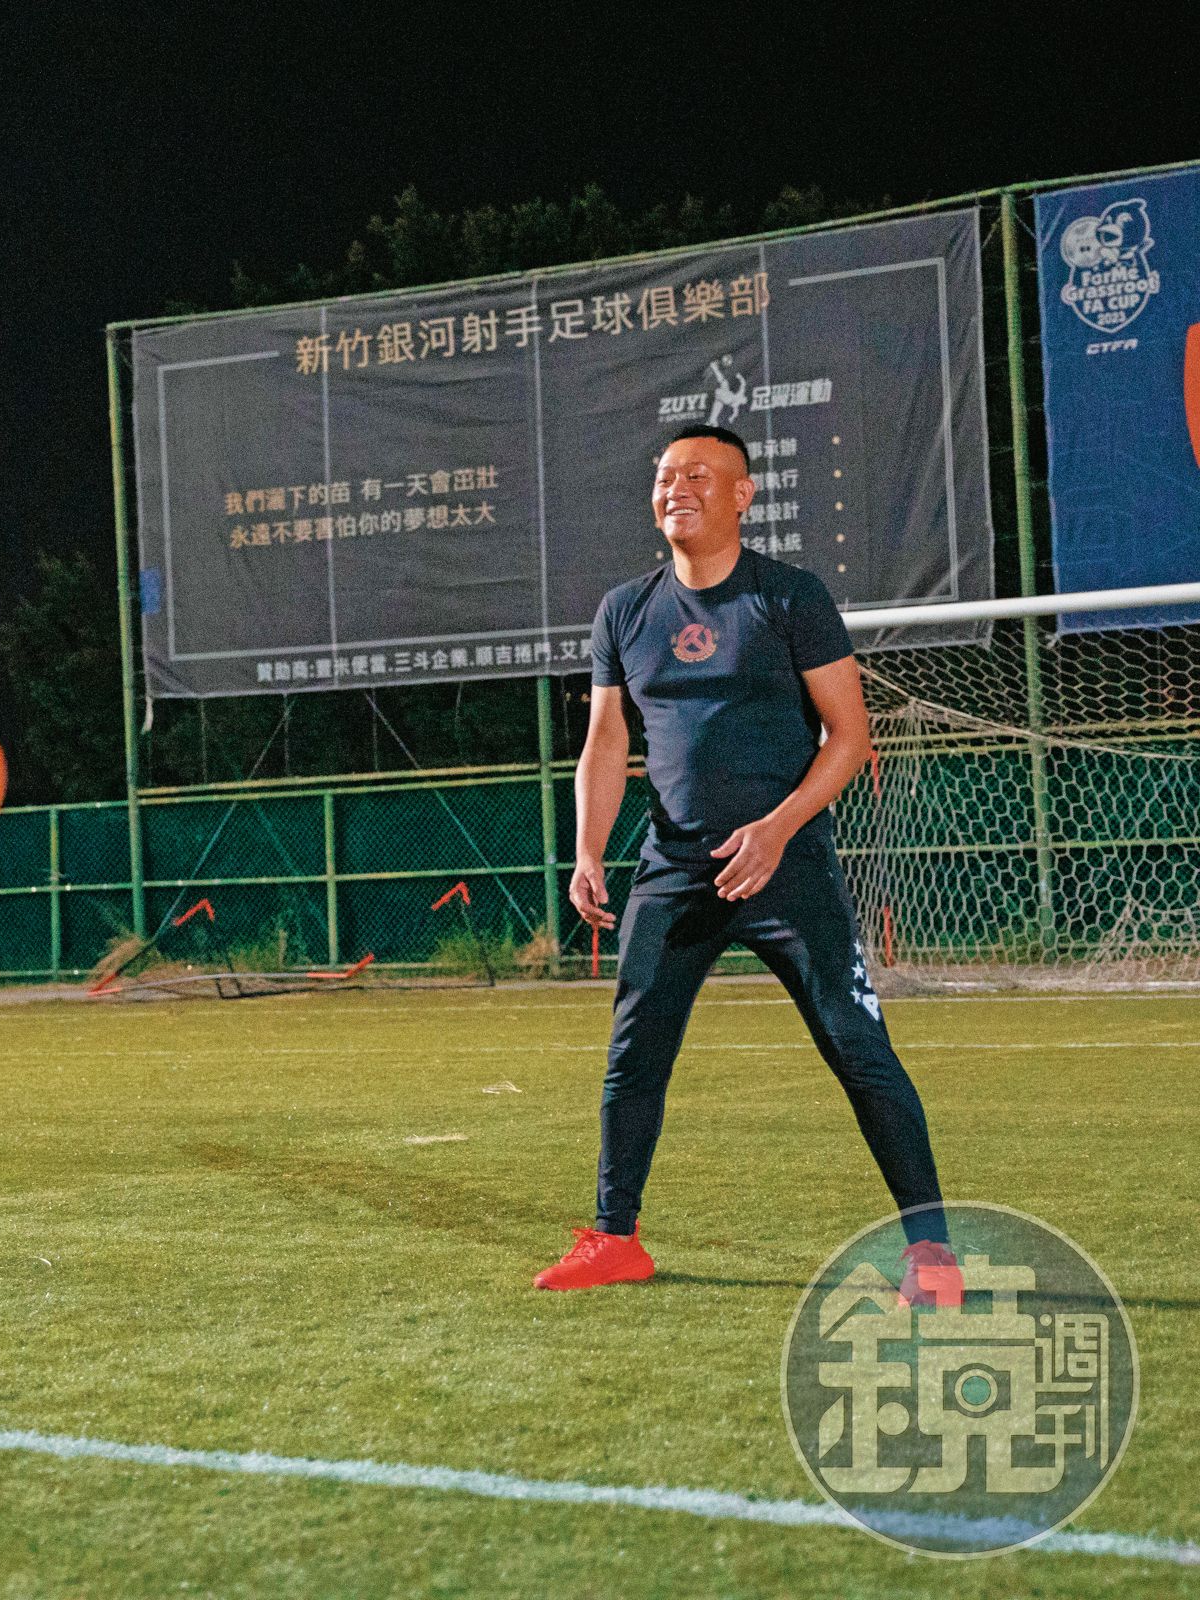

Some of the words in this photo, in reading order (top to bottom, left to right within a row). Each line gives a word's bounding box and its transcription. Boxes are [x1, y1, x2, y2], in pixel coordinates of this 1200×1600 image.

[1083, 299, 1104, 314] FA
[1107, 293, 1140, 310] CUP
[296, 272, 770, 375] 新竹銀河射手足球俱樂部
[1086, 338, 1138, 355] CTFA
[658, 393, 707, 414] ZUYI
[361, 465, 499, 501] 有一天會茁壯
[230, 501, 496, 549] 永遠不要害怕你的夢想太大
[741, 533, 802, 555] 名系統
